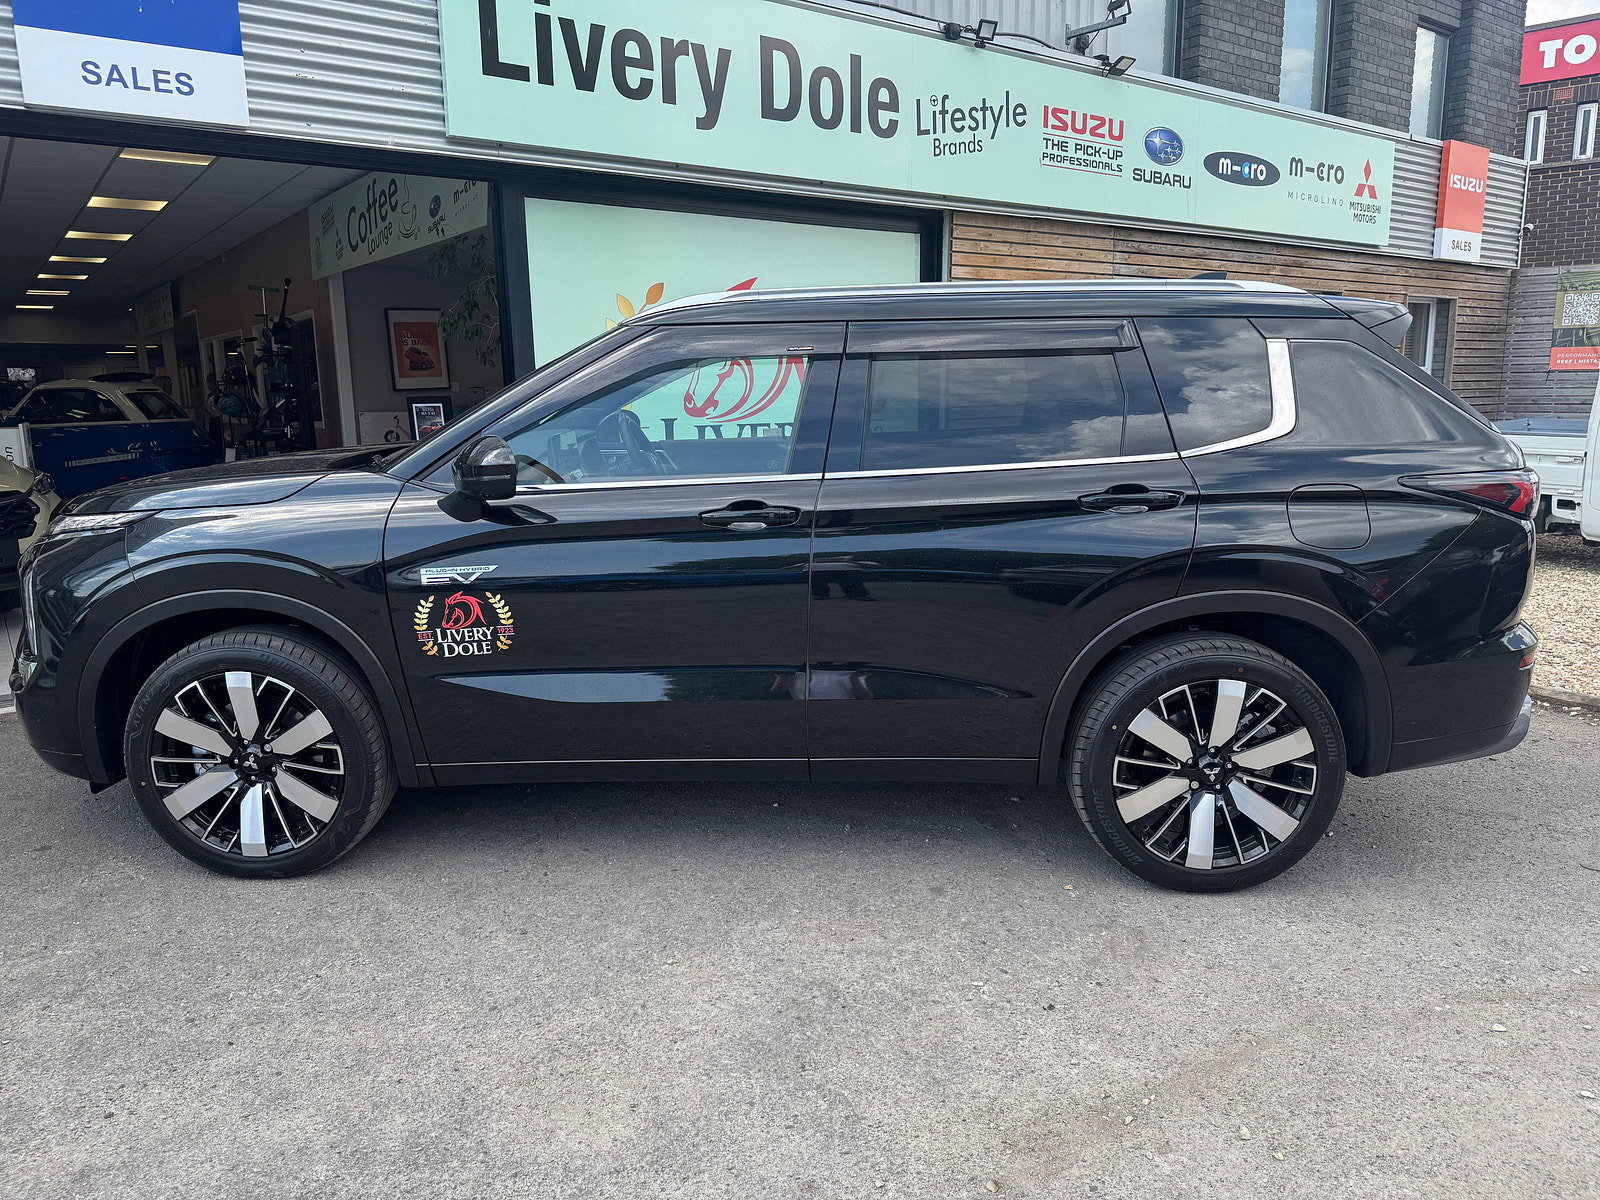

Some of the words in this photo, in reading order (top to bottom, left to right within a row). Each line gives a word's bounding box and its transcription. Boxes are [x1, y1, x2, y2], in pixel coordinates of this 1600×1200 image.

[1539, 34, 1600, 69] TO
[81, 60, 195, 96] SALES
[478, 0, 731, 130] Livery
[759, 35, 899, 139] Dole
[915, 91, 1027, 139] Lifestyle
[1042, 105, 1125, 141] ISUZU
[933, 133, 983, 157] Brands
[1042, 137, 1069, 153] THE
[1074, 142, 1123, 161] PICK-UP
[1042, 152, 1122, 173] PROFESSIONALS
[1289, 156, 1345, 185] m-cro
[1132, 168, 1192, 189] SUBARU
[1450, 174, 1484, 193] ISUZU
[1287, 191, 1344, 207] MICROLINO
[1349, 201, 1382, 214] MITSUBISHI
[347, 178, 399, 252] Coffee
[1352, 212, 1377, 225] MOTORS
[367, 221, 393, 255] Lounge
[1451, 239, 1472, 252] SALES
[435, 627, 494, 643] LIVERY
[443, 642, 492, 657] DOLE
